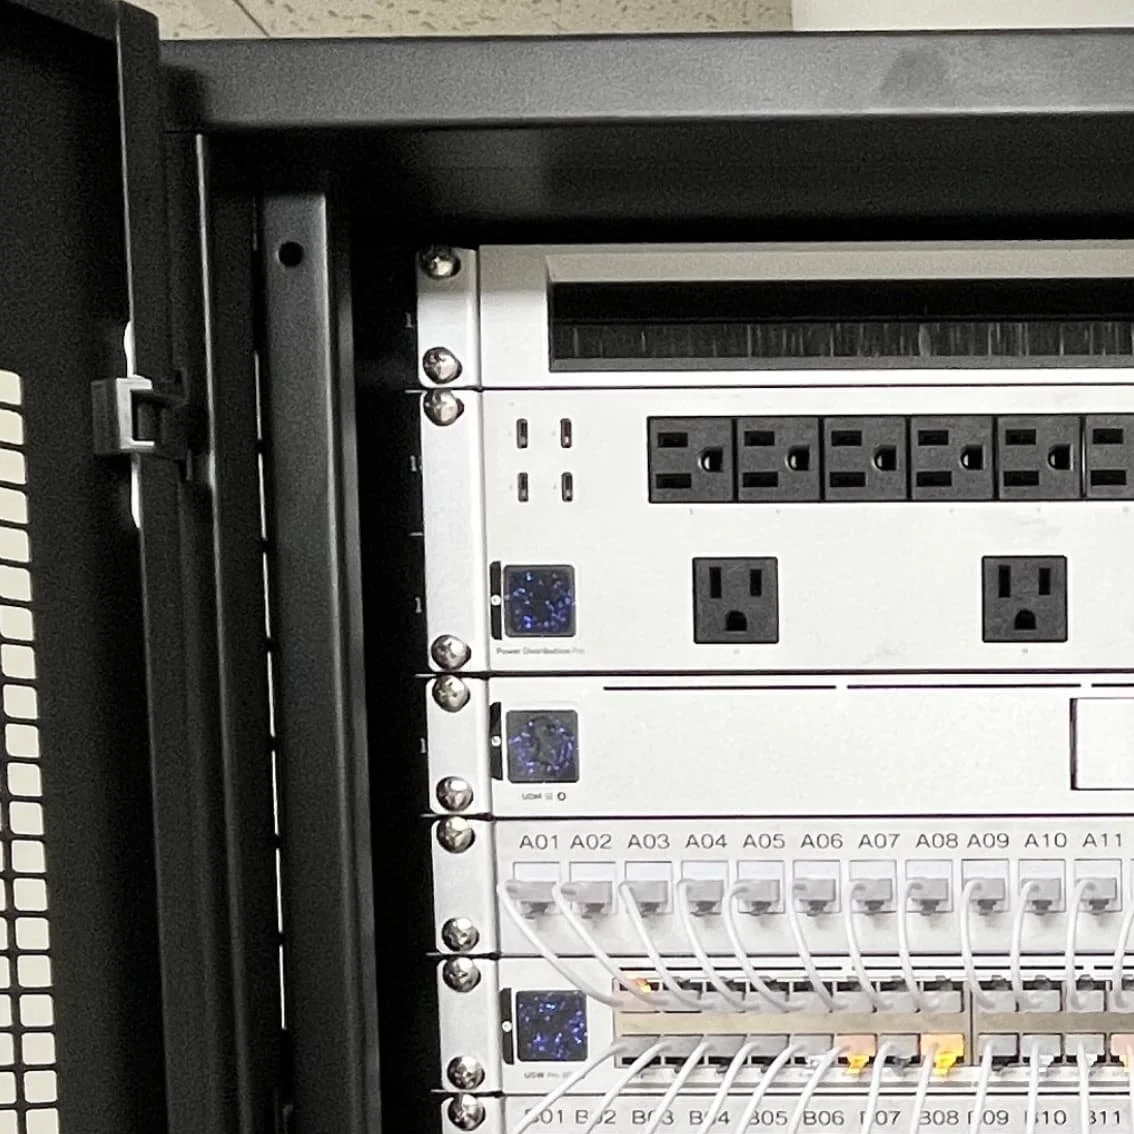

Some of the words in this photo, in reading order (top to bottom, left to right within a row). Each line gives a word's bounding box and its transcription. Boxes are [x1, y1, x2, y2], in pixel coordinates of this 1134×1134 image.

[519, 833, 561, 851] A01
[569, 833, 612, 851] A02
[627, 833, 671, 850] A03
[684, 833, 728, 850] A04
[742, 833, 786, 850] A05
[800, 832, 844, 850] A06
[857, 832, 901, 849] A07
[915, 832, 959, 849] A08
[966, 832, 1010, 849] A09
[1024, 832, 1068, 849] A10
[1081, 832, 1123, 849] A11
[689, 1109, 729, 1125] B4
[750, 1109, 788, 1125] B05
[803, 1109, 845, 1126] B06
[920, 1109, 960, 1126] B08
